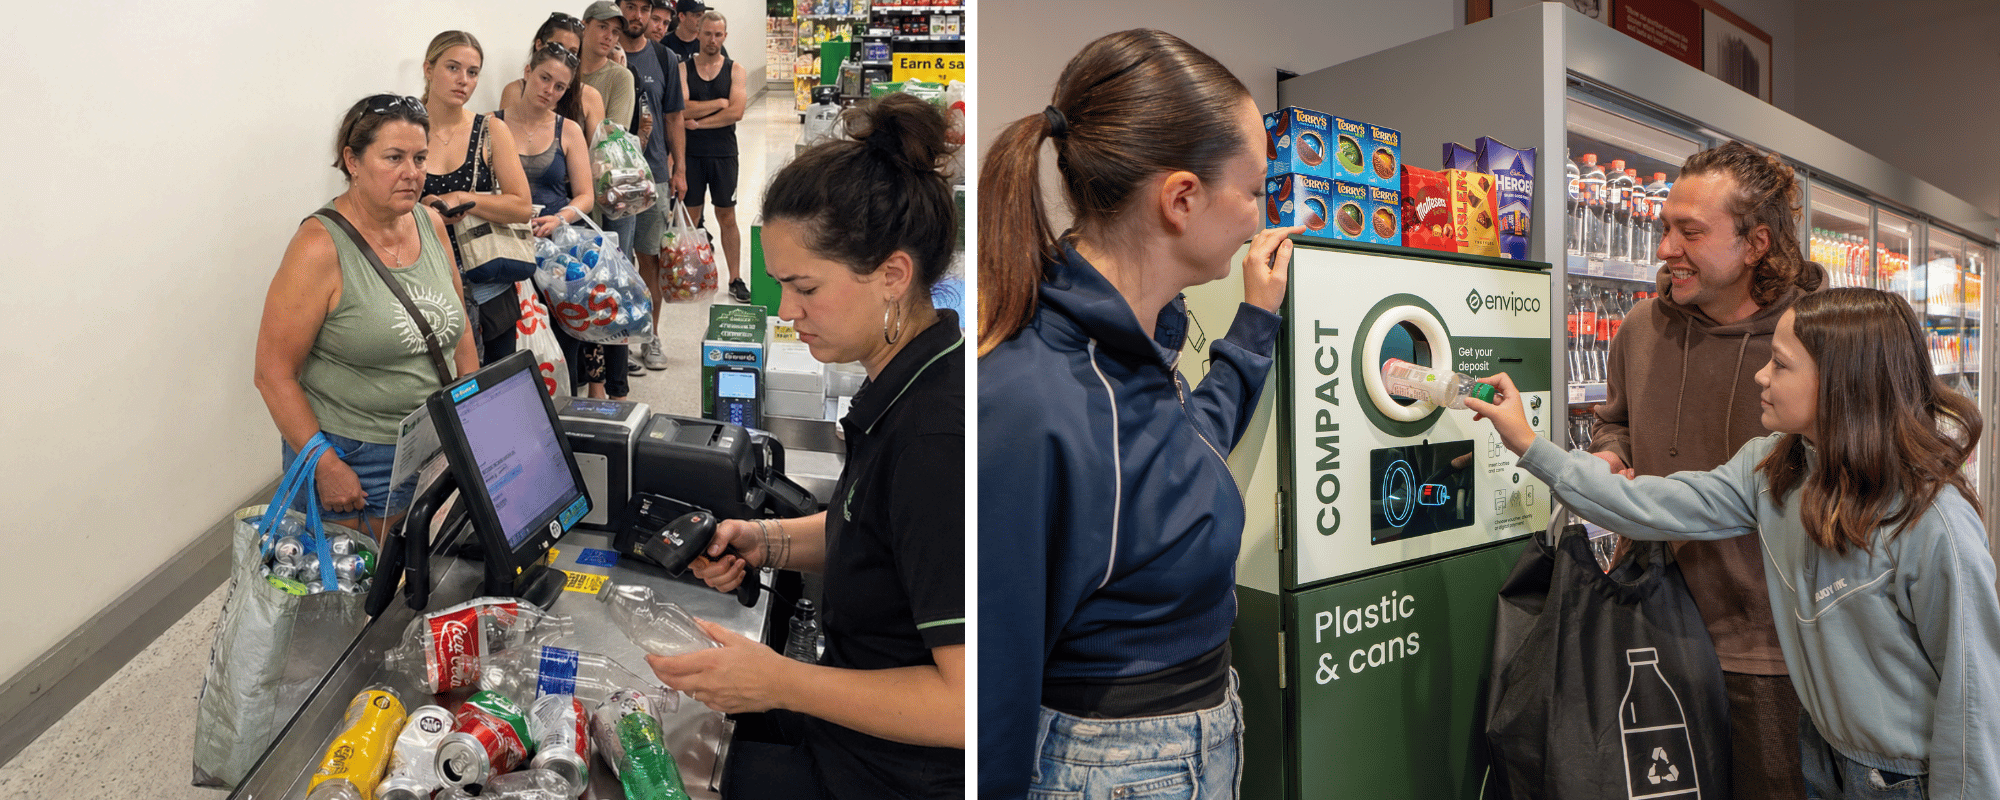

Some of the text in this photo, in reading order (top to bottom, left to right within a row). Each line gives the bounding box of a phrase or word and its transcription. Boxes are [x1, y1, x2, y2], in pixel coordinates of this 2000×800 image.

[900, 57, 931, 69] Earn
[934, 57, 945, 69] &
[1495, 173, 1533, 197] HEROES
[1416, 196, 1447, 222] Maltesers
[1485, 291, 1541, 316] envipco
[1459, 347, 1493, 359] Get your
[1459, 361, 1489, 374] deposit
[1314, 319, 1341, 536] COMPACT
[1315, 590, 1415, 643] Plastic
[1315, 631, 1420, 685] & cans
